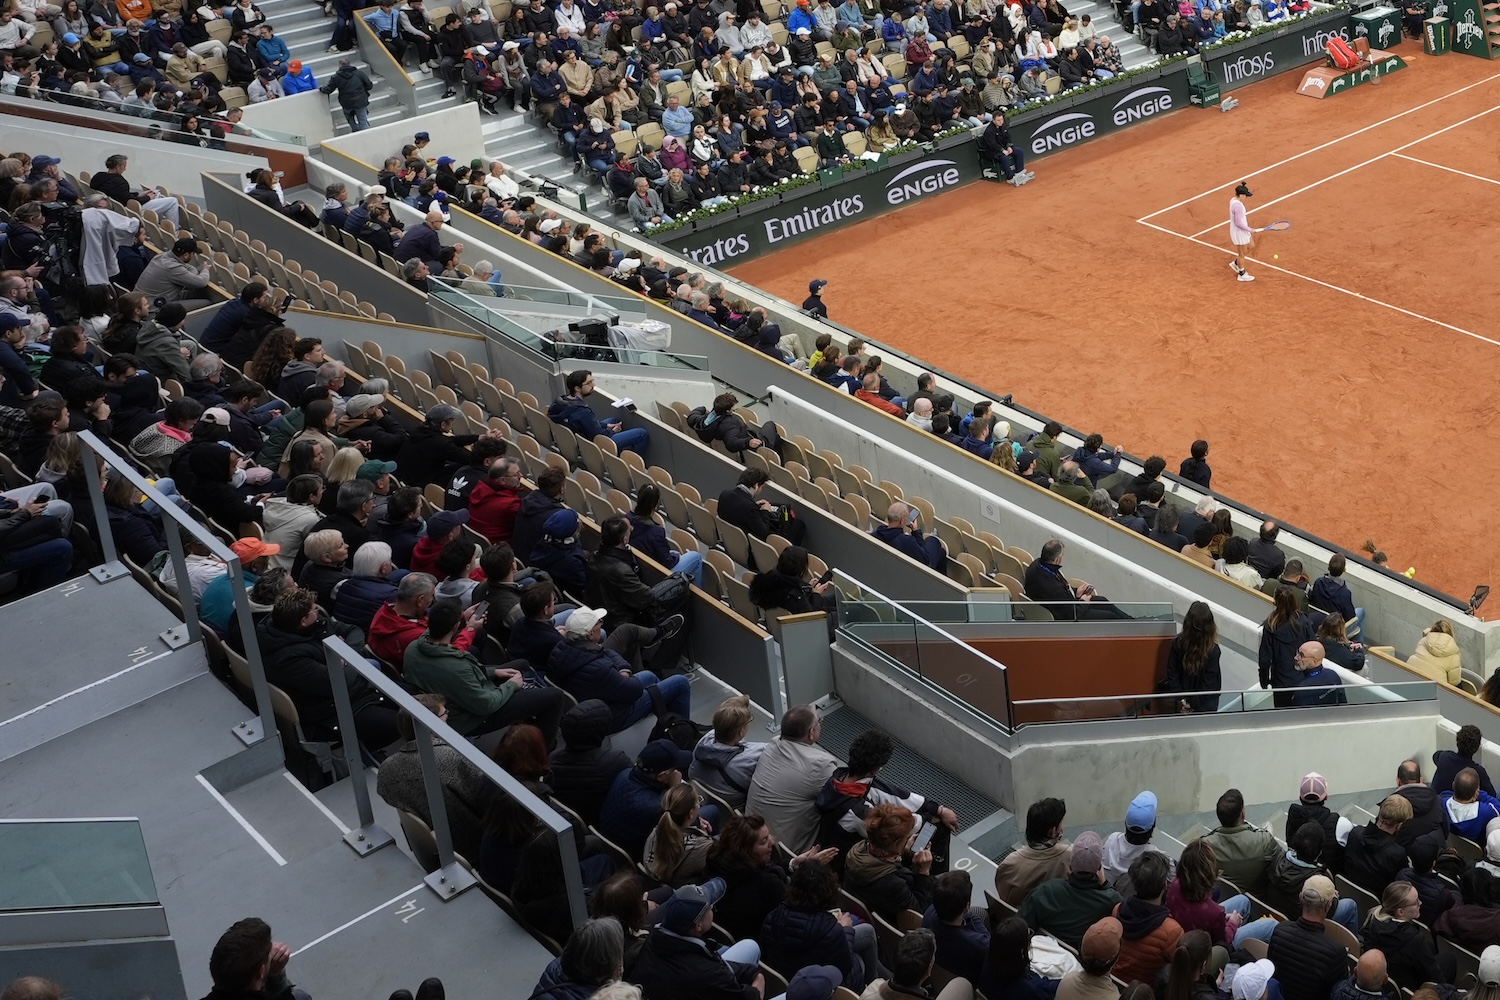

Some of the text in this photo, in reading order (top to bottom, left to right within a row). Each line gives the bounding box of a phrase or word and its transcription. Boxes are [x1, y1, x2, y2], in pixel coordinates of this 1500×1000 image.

[1302, 26, 1349, 56] Infos
[1427, 24, 1436, 51] Wilson
[1222, 51, 1274, 84] Infosys
[764, 194, 864, 244] Emirates
[60, 582, 84, 597] 14
[128, 646, 153, 662] 14
[954, 858, 978, 872] 10
[394, 899, 425, 924] 14
